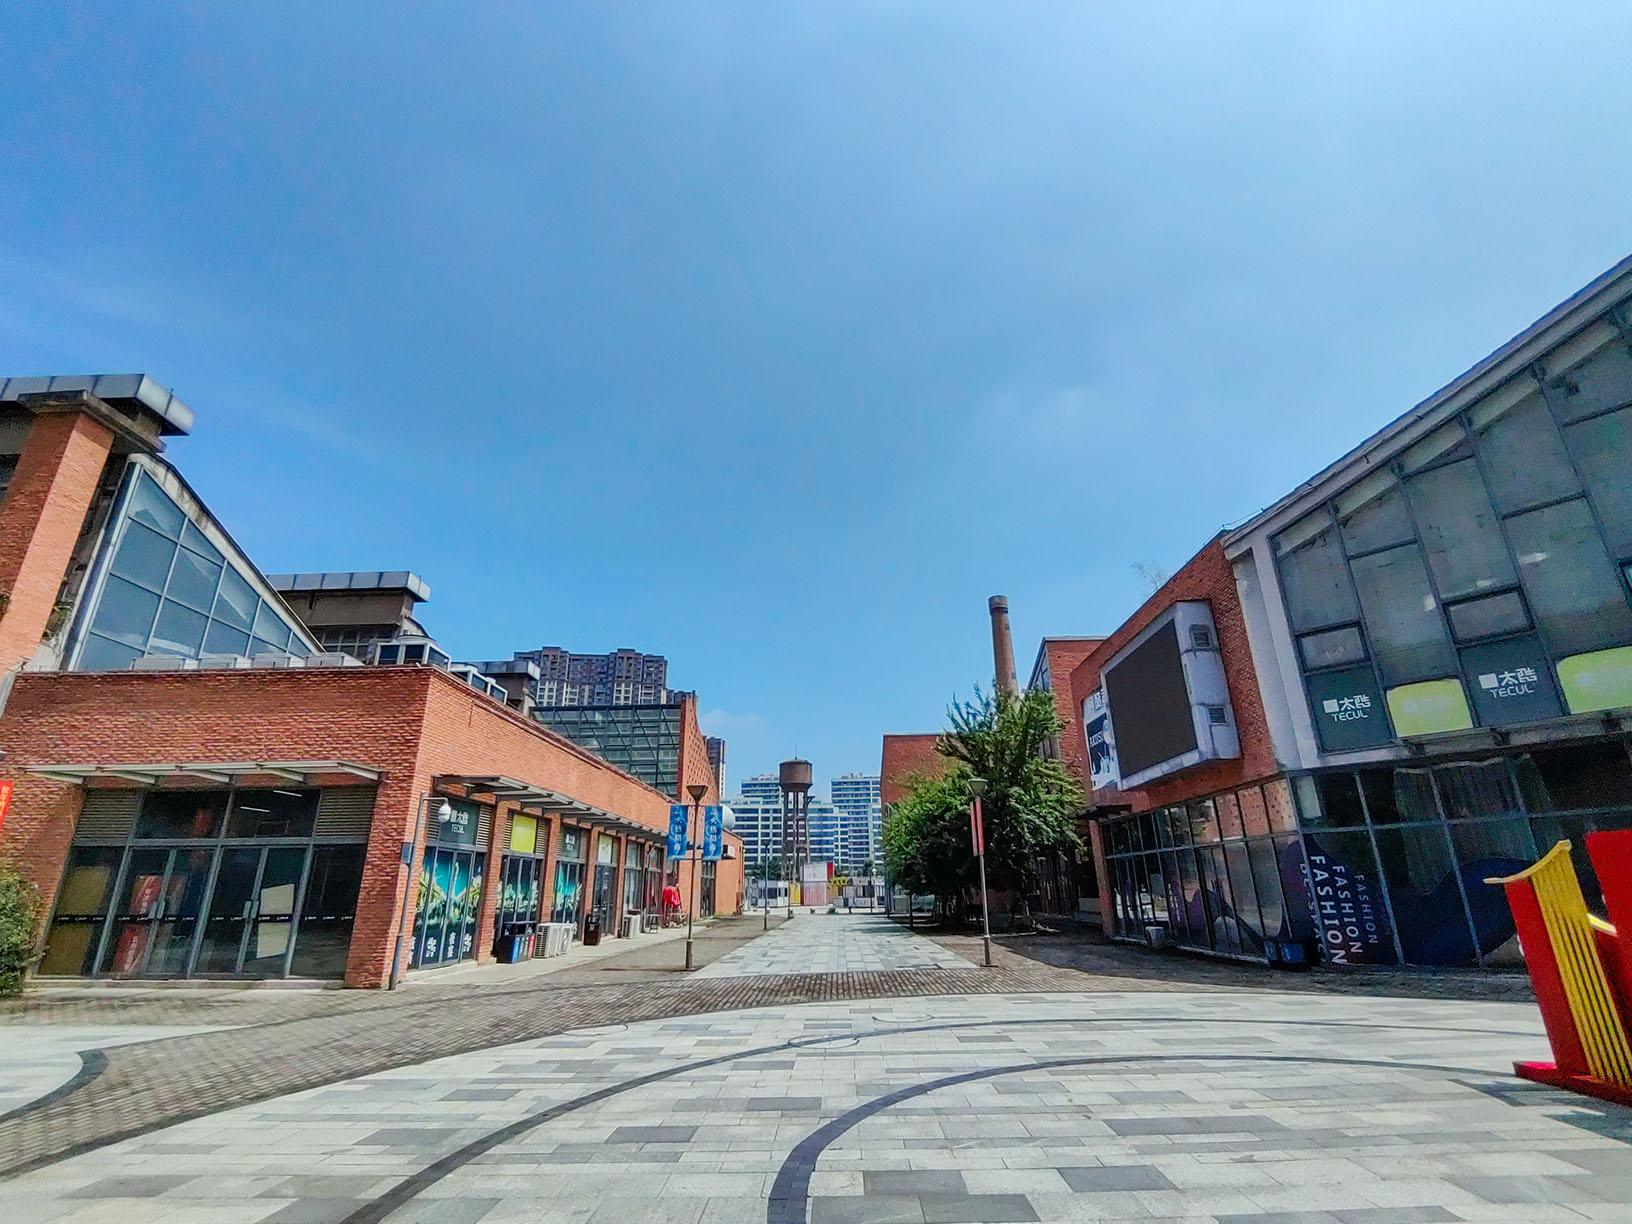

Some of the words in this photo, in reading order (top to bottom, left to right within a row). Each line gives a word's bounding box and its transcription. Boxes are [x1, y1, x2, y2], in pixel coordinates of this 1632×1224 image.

[1331, 710, 1368, 722] TECUL
[1490, 684, 1535, 698] TECUL
[1310, 855, 1348, 964] FASHION
[1332, 865, 1363, 953] FASHION
[1354, 875, 1378, 943] FASHION
